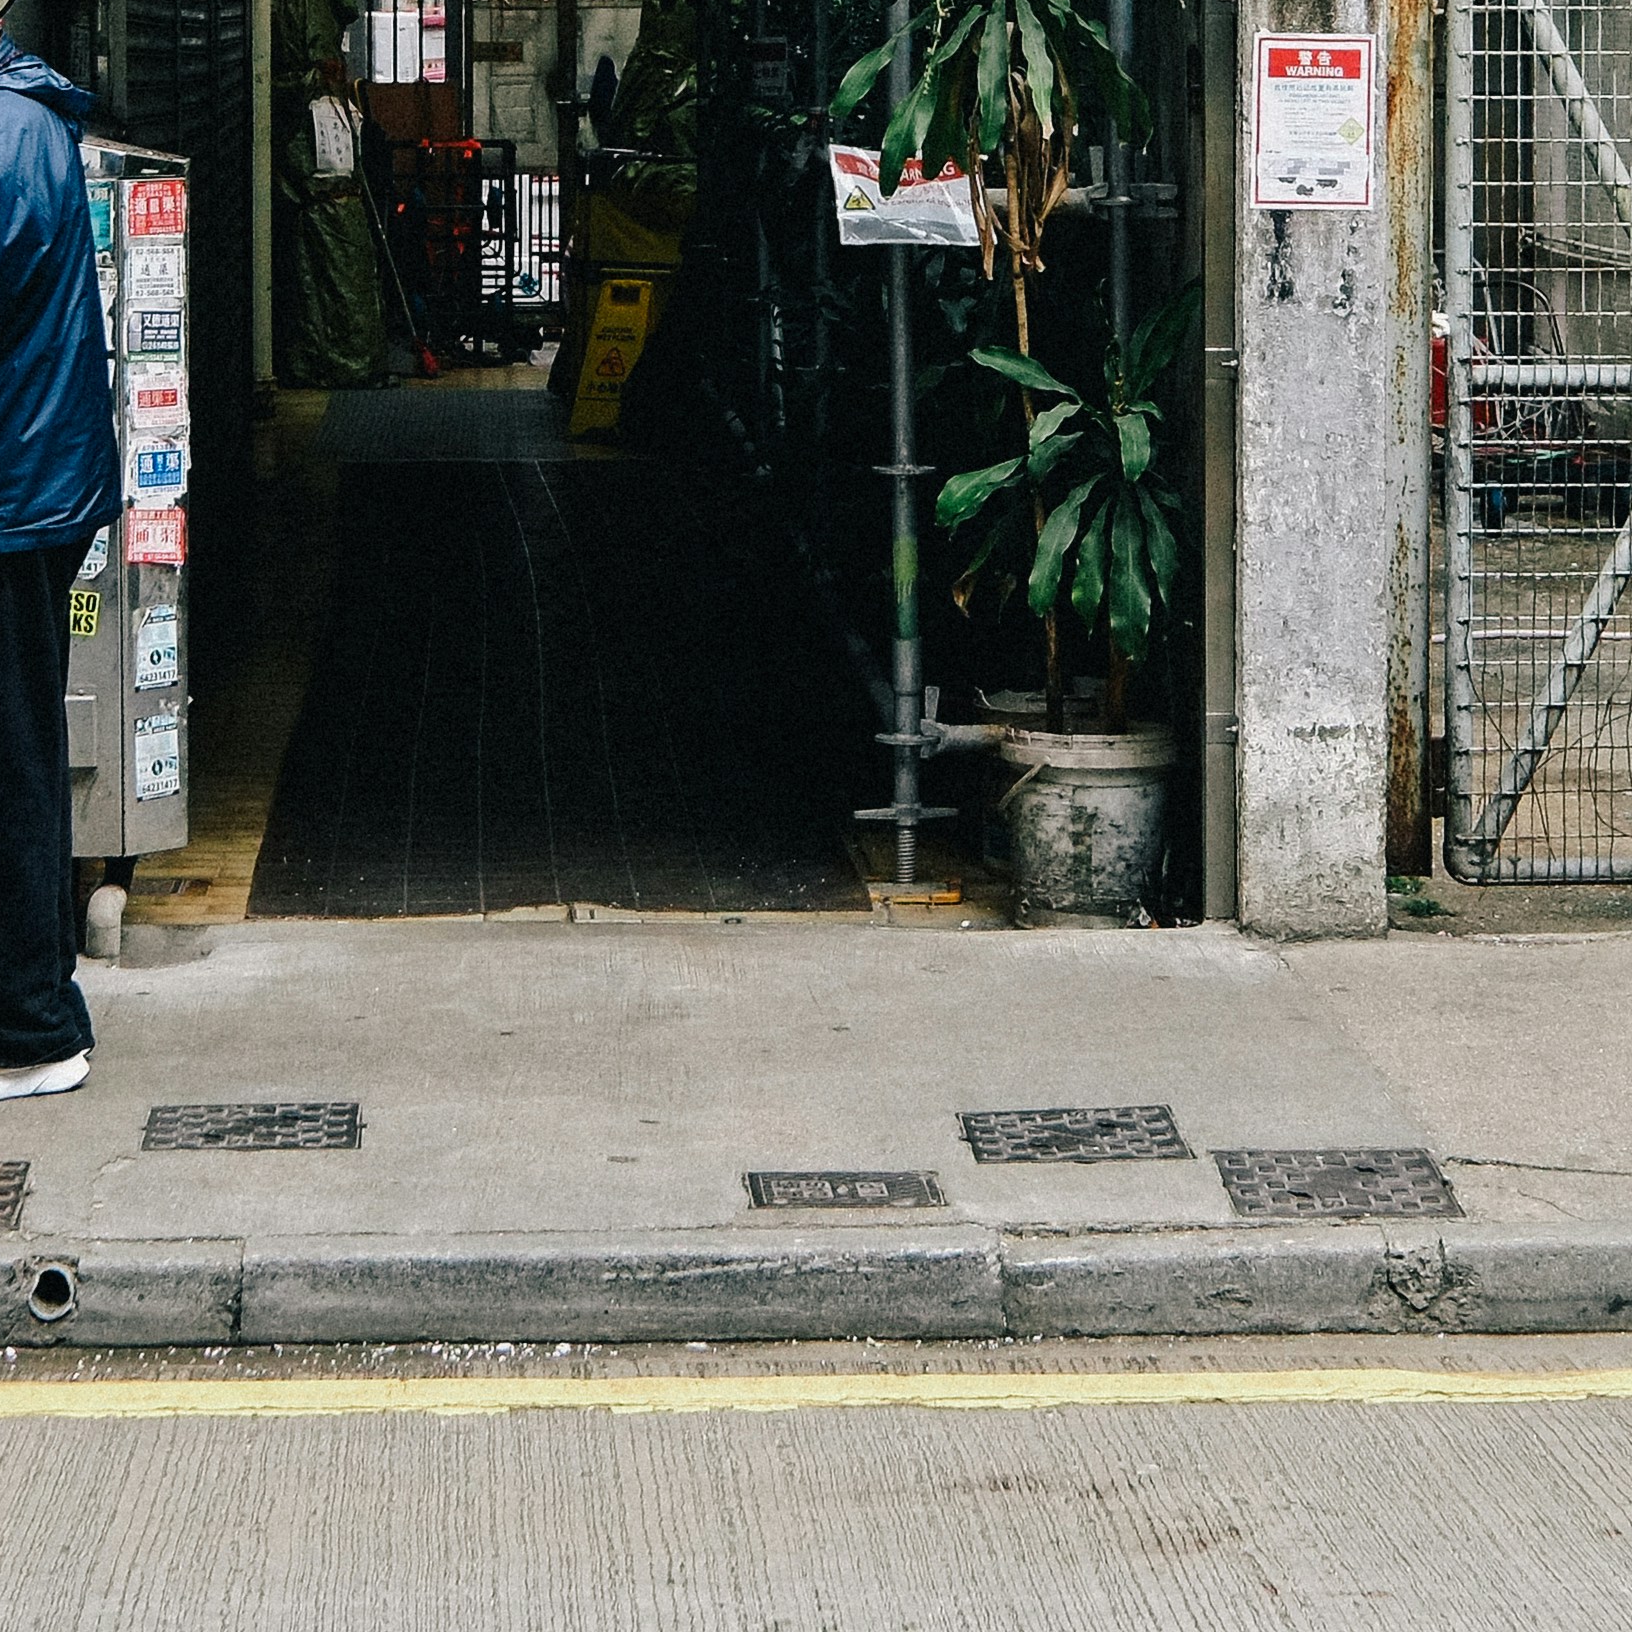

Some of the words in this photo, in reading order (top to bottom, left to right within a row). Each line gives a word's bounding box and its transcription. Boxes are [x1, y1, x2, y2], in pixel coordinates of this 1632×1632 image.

[1298, 50, 1332, 66] 警告
[1285, 65, 1344, 78] WARNING
[69, 593, 98, 613] SO
